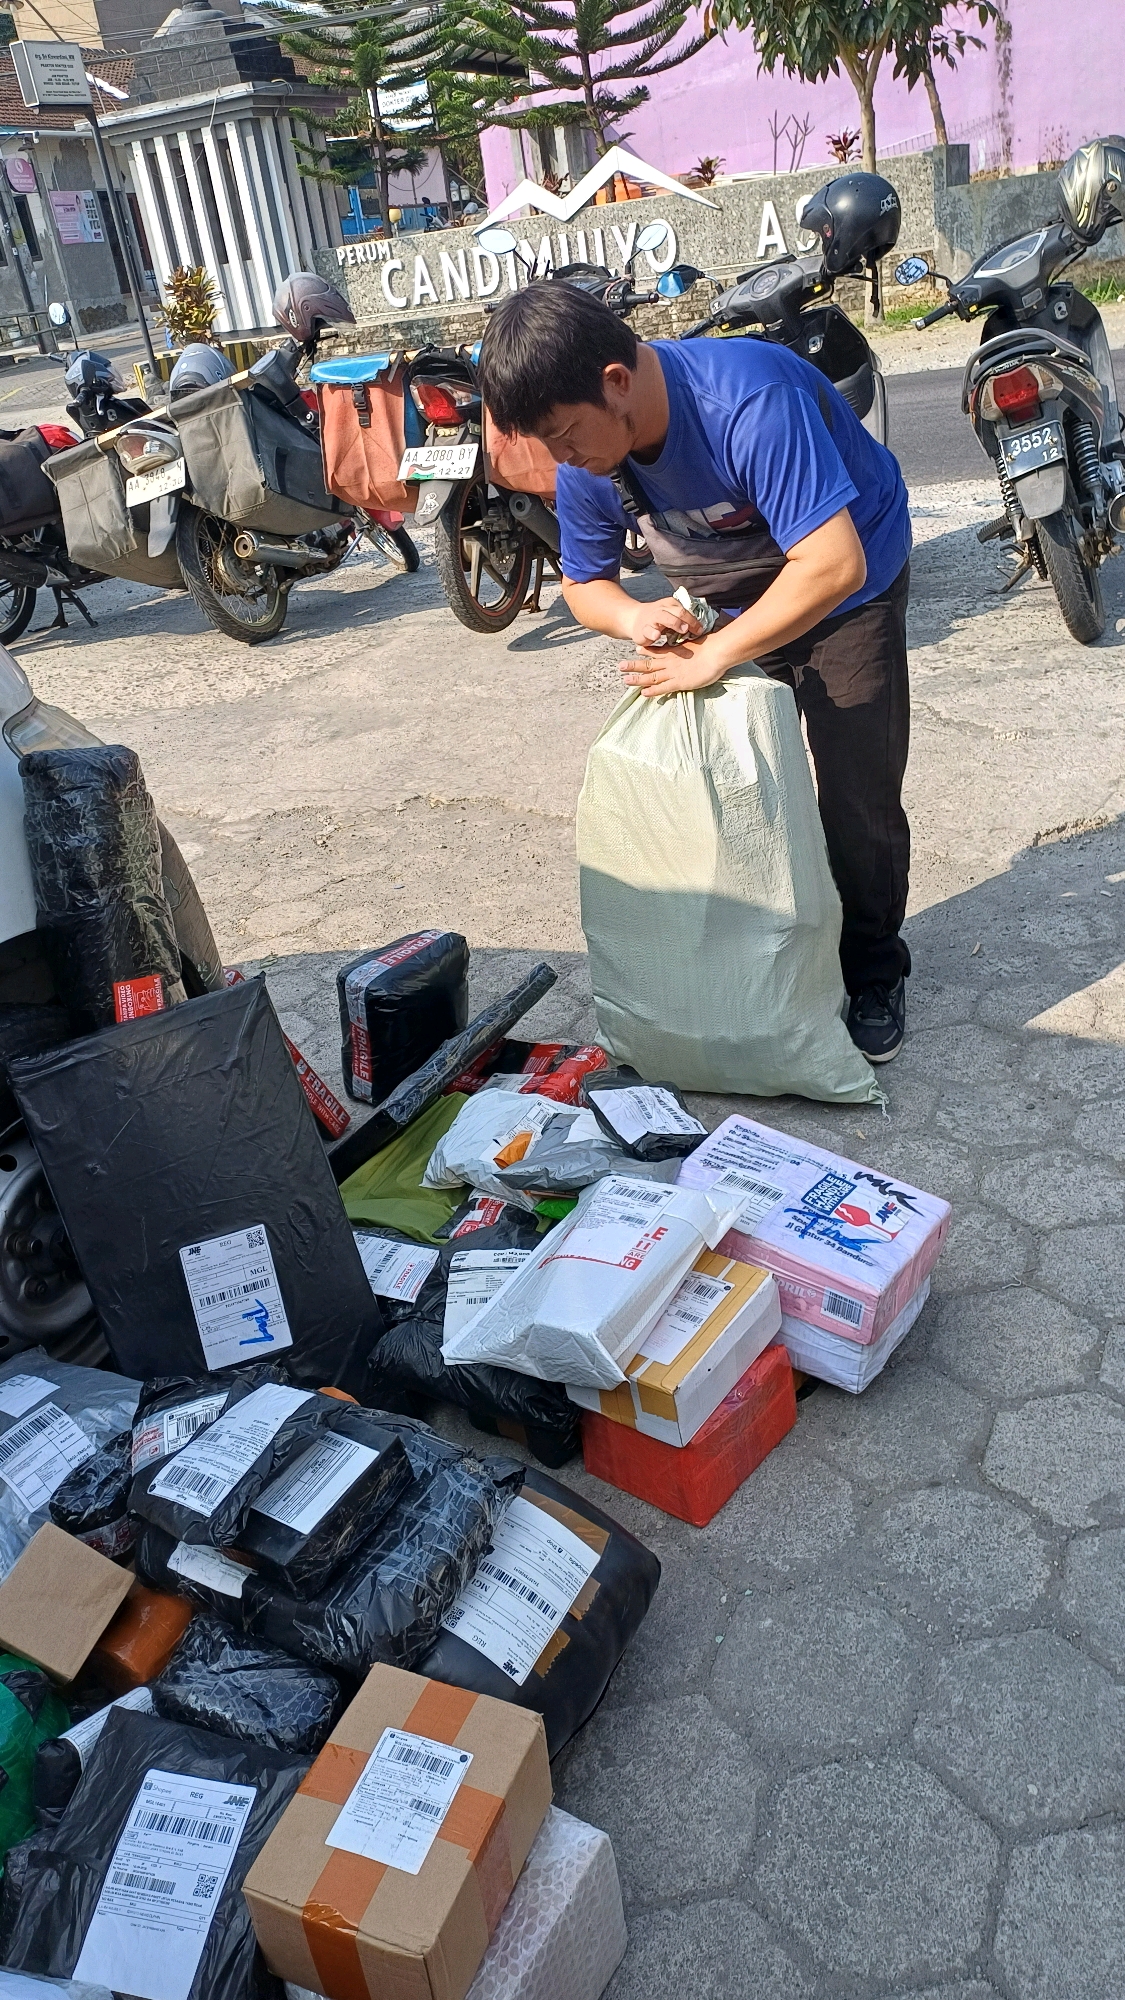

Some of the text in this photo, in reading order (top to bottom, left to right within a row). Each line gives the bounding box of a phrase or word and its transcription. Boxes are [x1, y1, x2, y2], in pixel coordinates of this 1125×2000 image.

[336, 243, 391, 266] PERUM
[1010, 427, 1052, 457] 3552
[404, 447, 474, 463] AA 2080 BY
[1042, 447, 1059, 461] 12
[385, 938, 433, 966] FRAGILE
[356, 1029, 370, 1080] FRAGILE
[306, 1071, 348, 1124] FRAGILE
[316, 1103, 330, 1120] WITH
[804, 1175, 836, 1205] FRAGILE
[815, 1178, 846, 1208] HANDLE
[823, 1183, 854, 1212] WITH CARE
[876, 1201, 898, 1226] JNE
[794, 1225, 824, 1242] Guntur
[188, 1246, 202, 1256] JNE
[627, 1251, 645, 1260] ARE
[250, 1266, 268, 1276] MGL
[471, 1634, 487, 1649] REG
[502, 1661, 521, 1677] JNE
[152, 1783, 251, 1808] Shopee REG JNE
